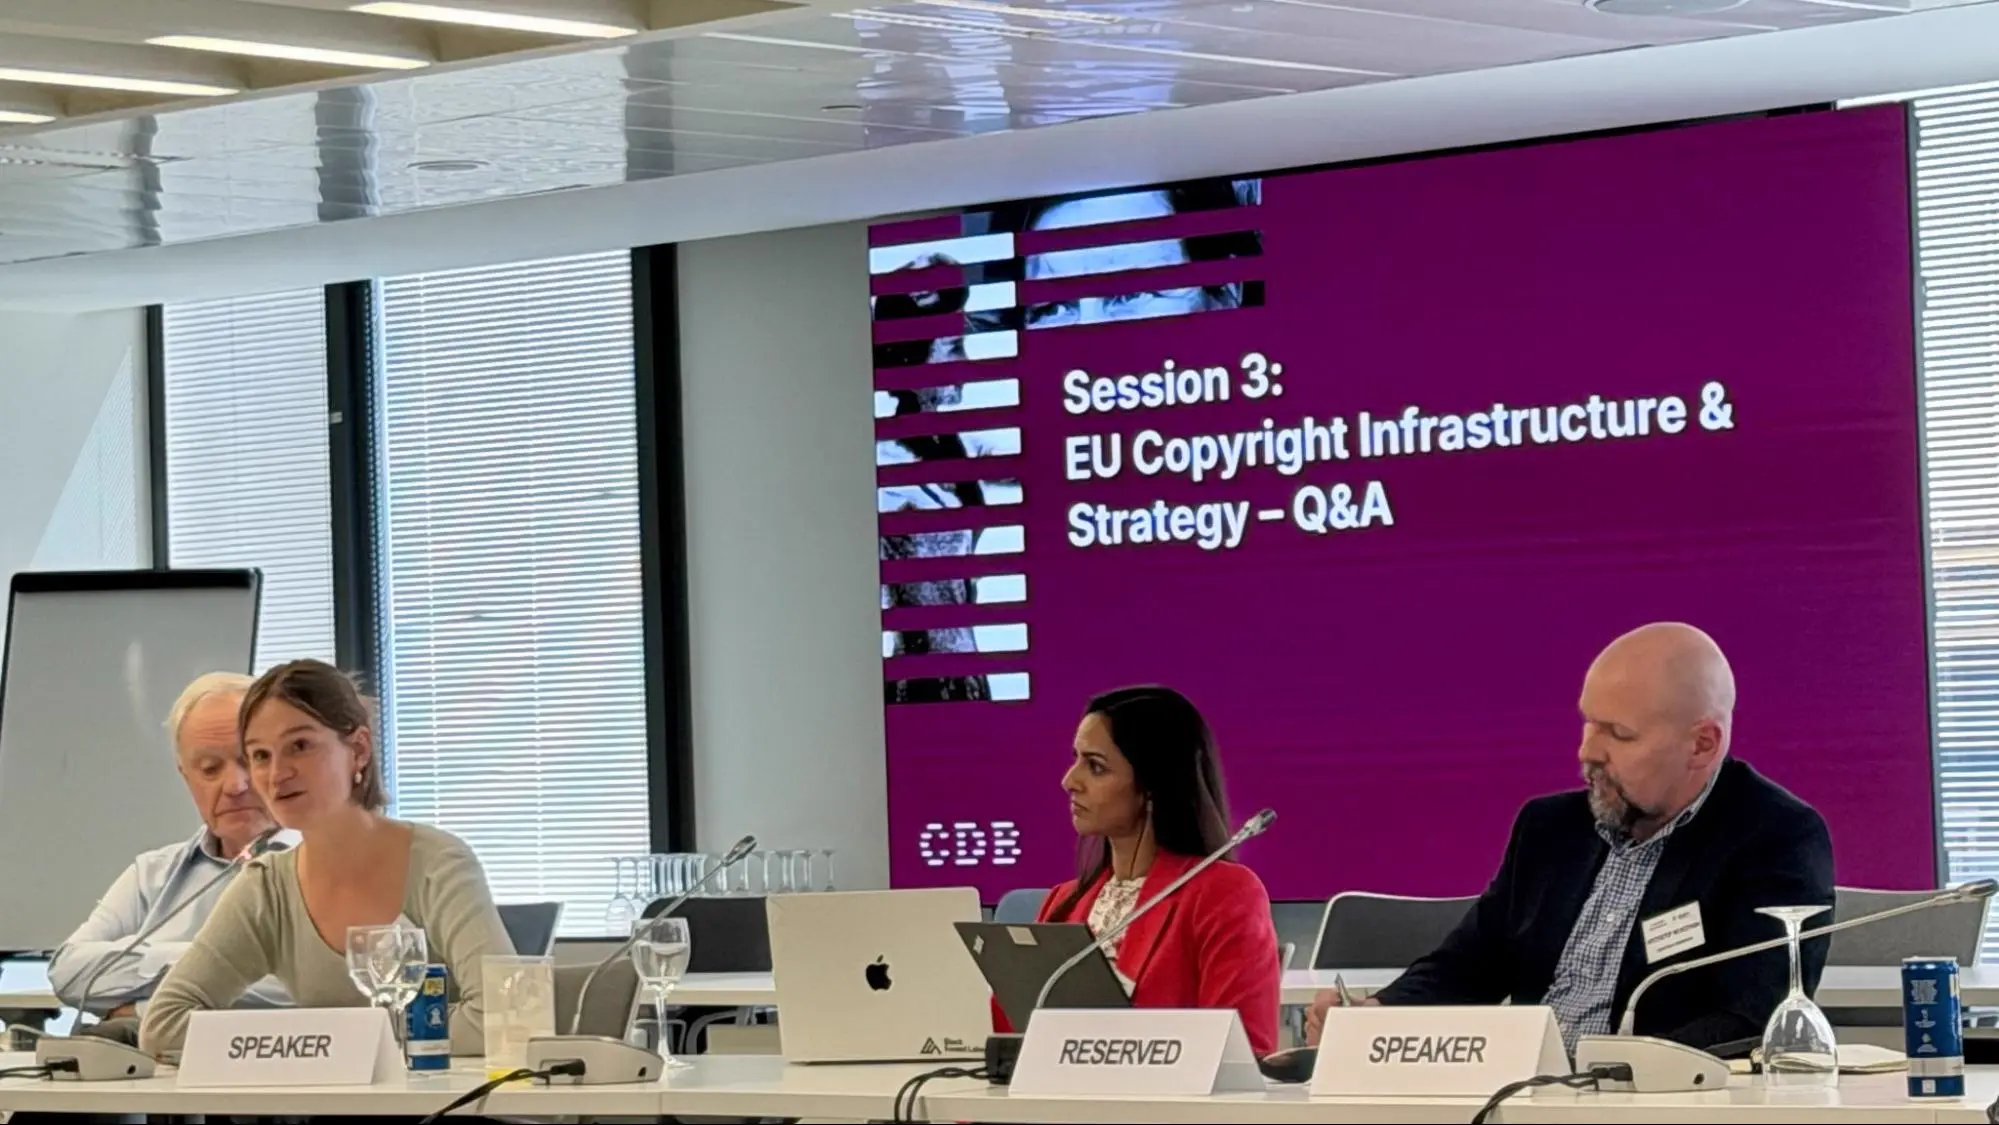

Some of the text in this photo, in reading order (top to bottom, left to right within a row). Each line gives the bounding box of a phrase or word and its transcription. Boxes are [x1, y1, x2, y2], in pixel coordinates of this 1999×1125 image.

[1063, 352, 1283, 414] Session 3:
[1065, 381, 1734, 482] EU Copyright Infrastructure &
[1067, 499, 1250, 550] Strategy
[1292, 480, 1394, 534] Q&A
[228, 1035, 332, 1060] SPEAKER
[1058, 1039, 1182, 1065] RESERVED
[1369, 1036, 1487, 1064] SPEAKER
